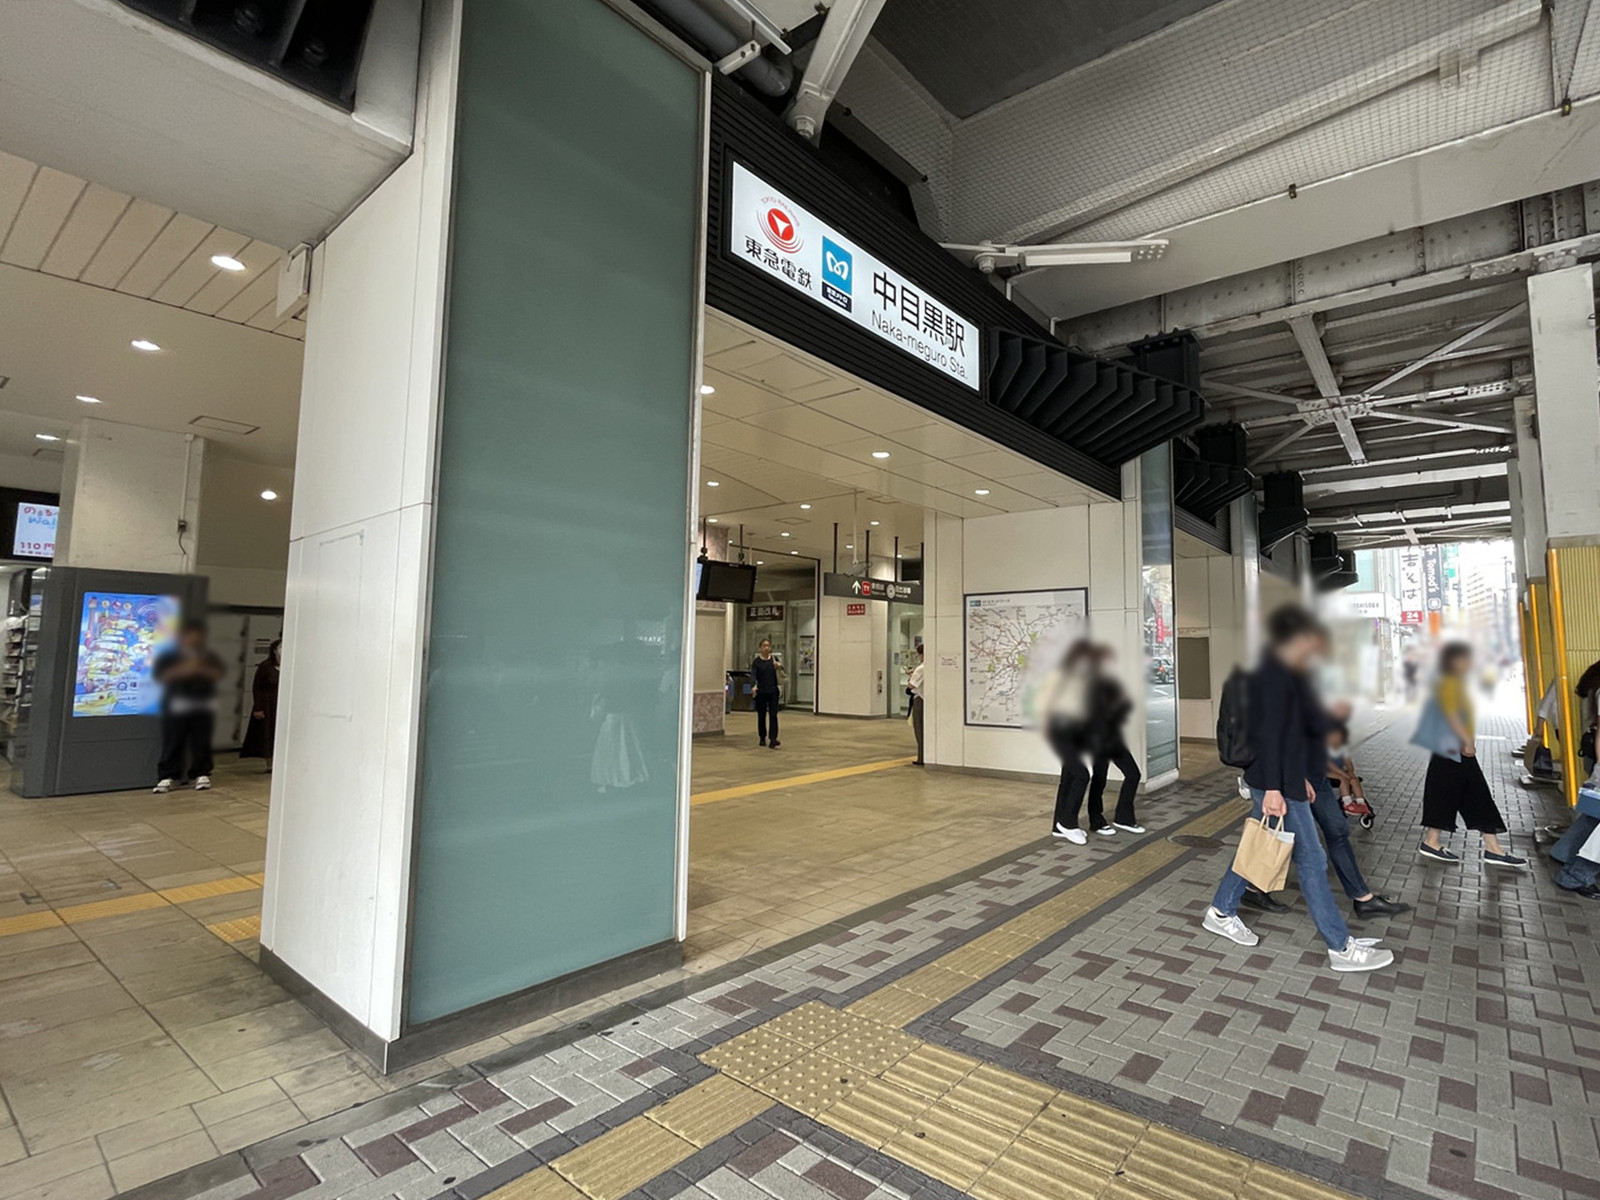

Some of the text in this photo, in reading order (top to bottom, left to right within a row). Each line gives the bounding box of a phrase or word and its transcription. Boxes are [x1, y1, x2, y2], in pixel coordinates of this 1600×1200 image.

[744, 234, 813, 291] 東急電鉄
[873, 271, 965, 358] 中目黒駅
[871, 309, 968, 380] Naka-meguro Sta.
[1426, 558, 1440, 593] Tomod's
[1406, 611, 1419, 619] 24
